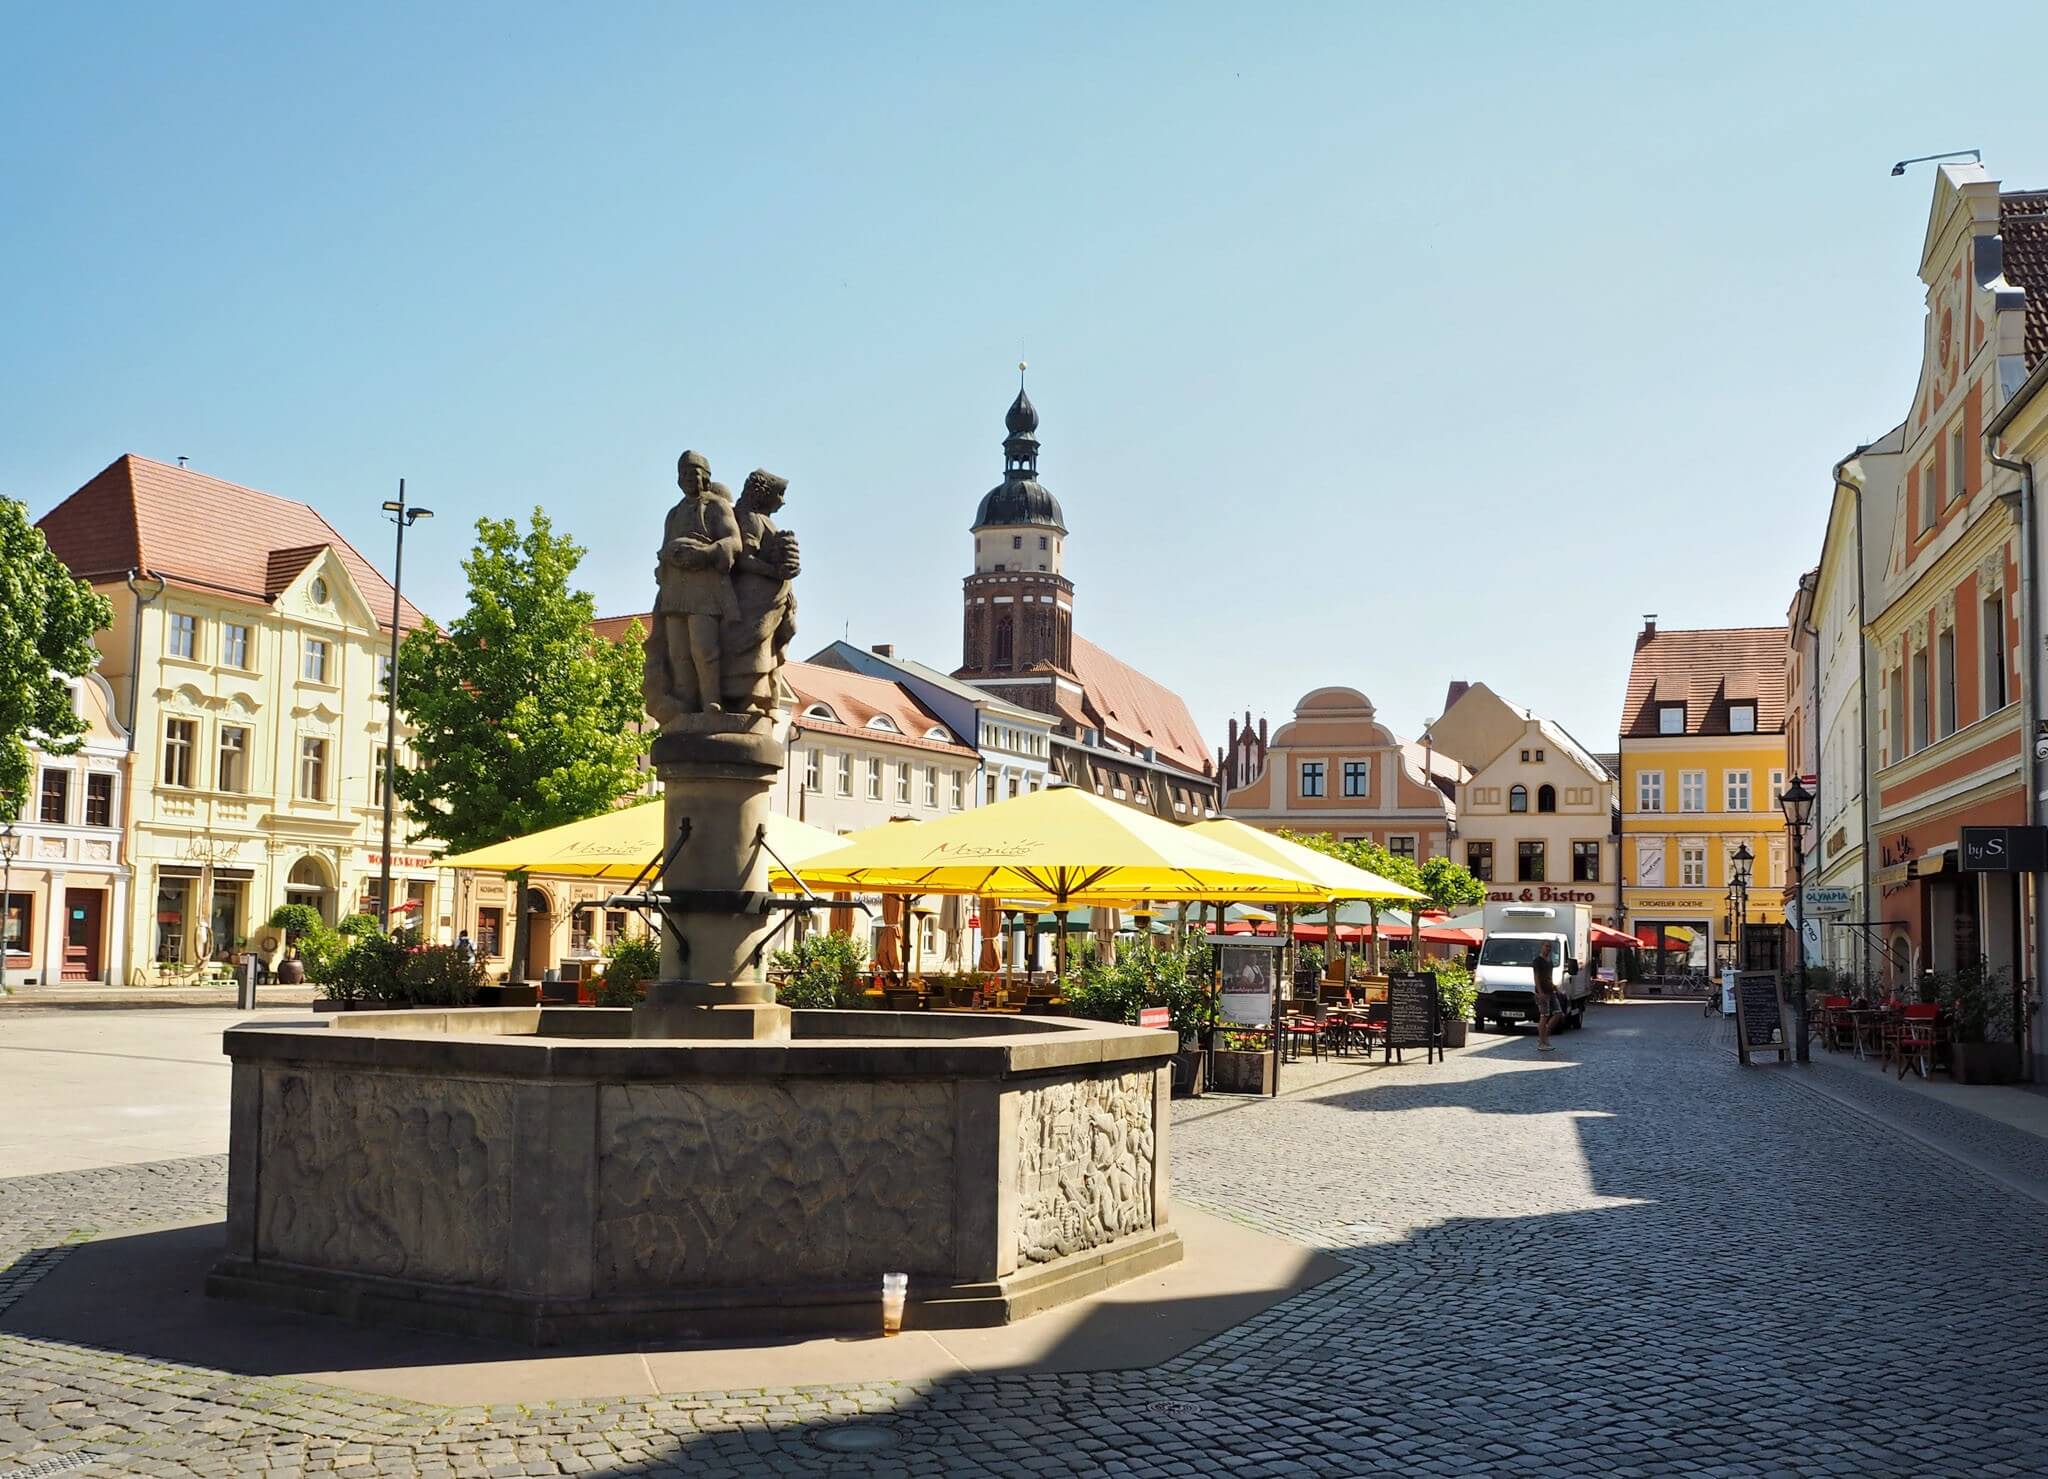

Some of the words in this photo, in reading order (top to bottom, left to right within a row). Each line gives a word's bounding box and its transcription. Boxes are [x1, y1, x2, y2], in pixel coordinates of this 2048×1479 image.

[1968, 843, 1983, 860] by
[1485, 891, 1514, 902] rau
[1519, 888, 1534, 902] &
[1538, 887, 1595, 903] Bistro
[1806, 892, 1848, 901] OLYMPIA
